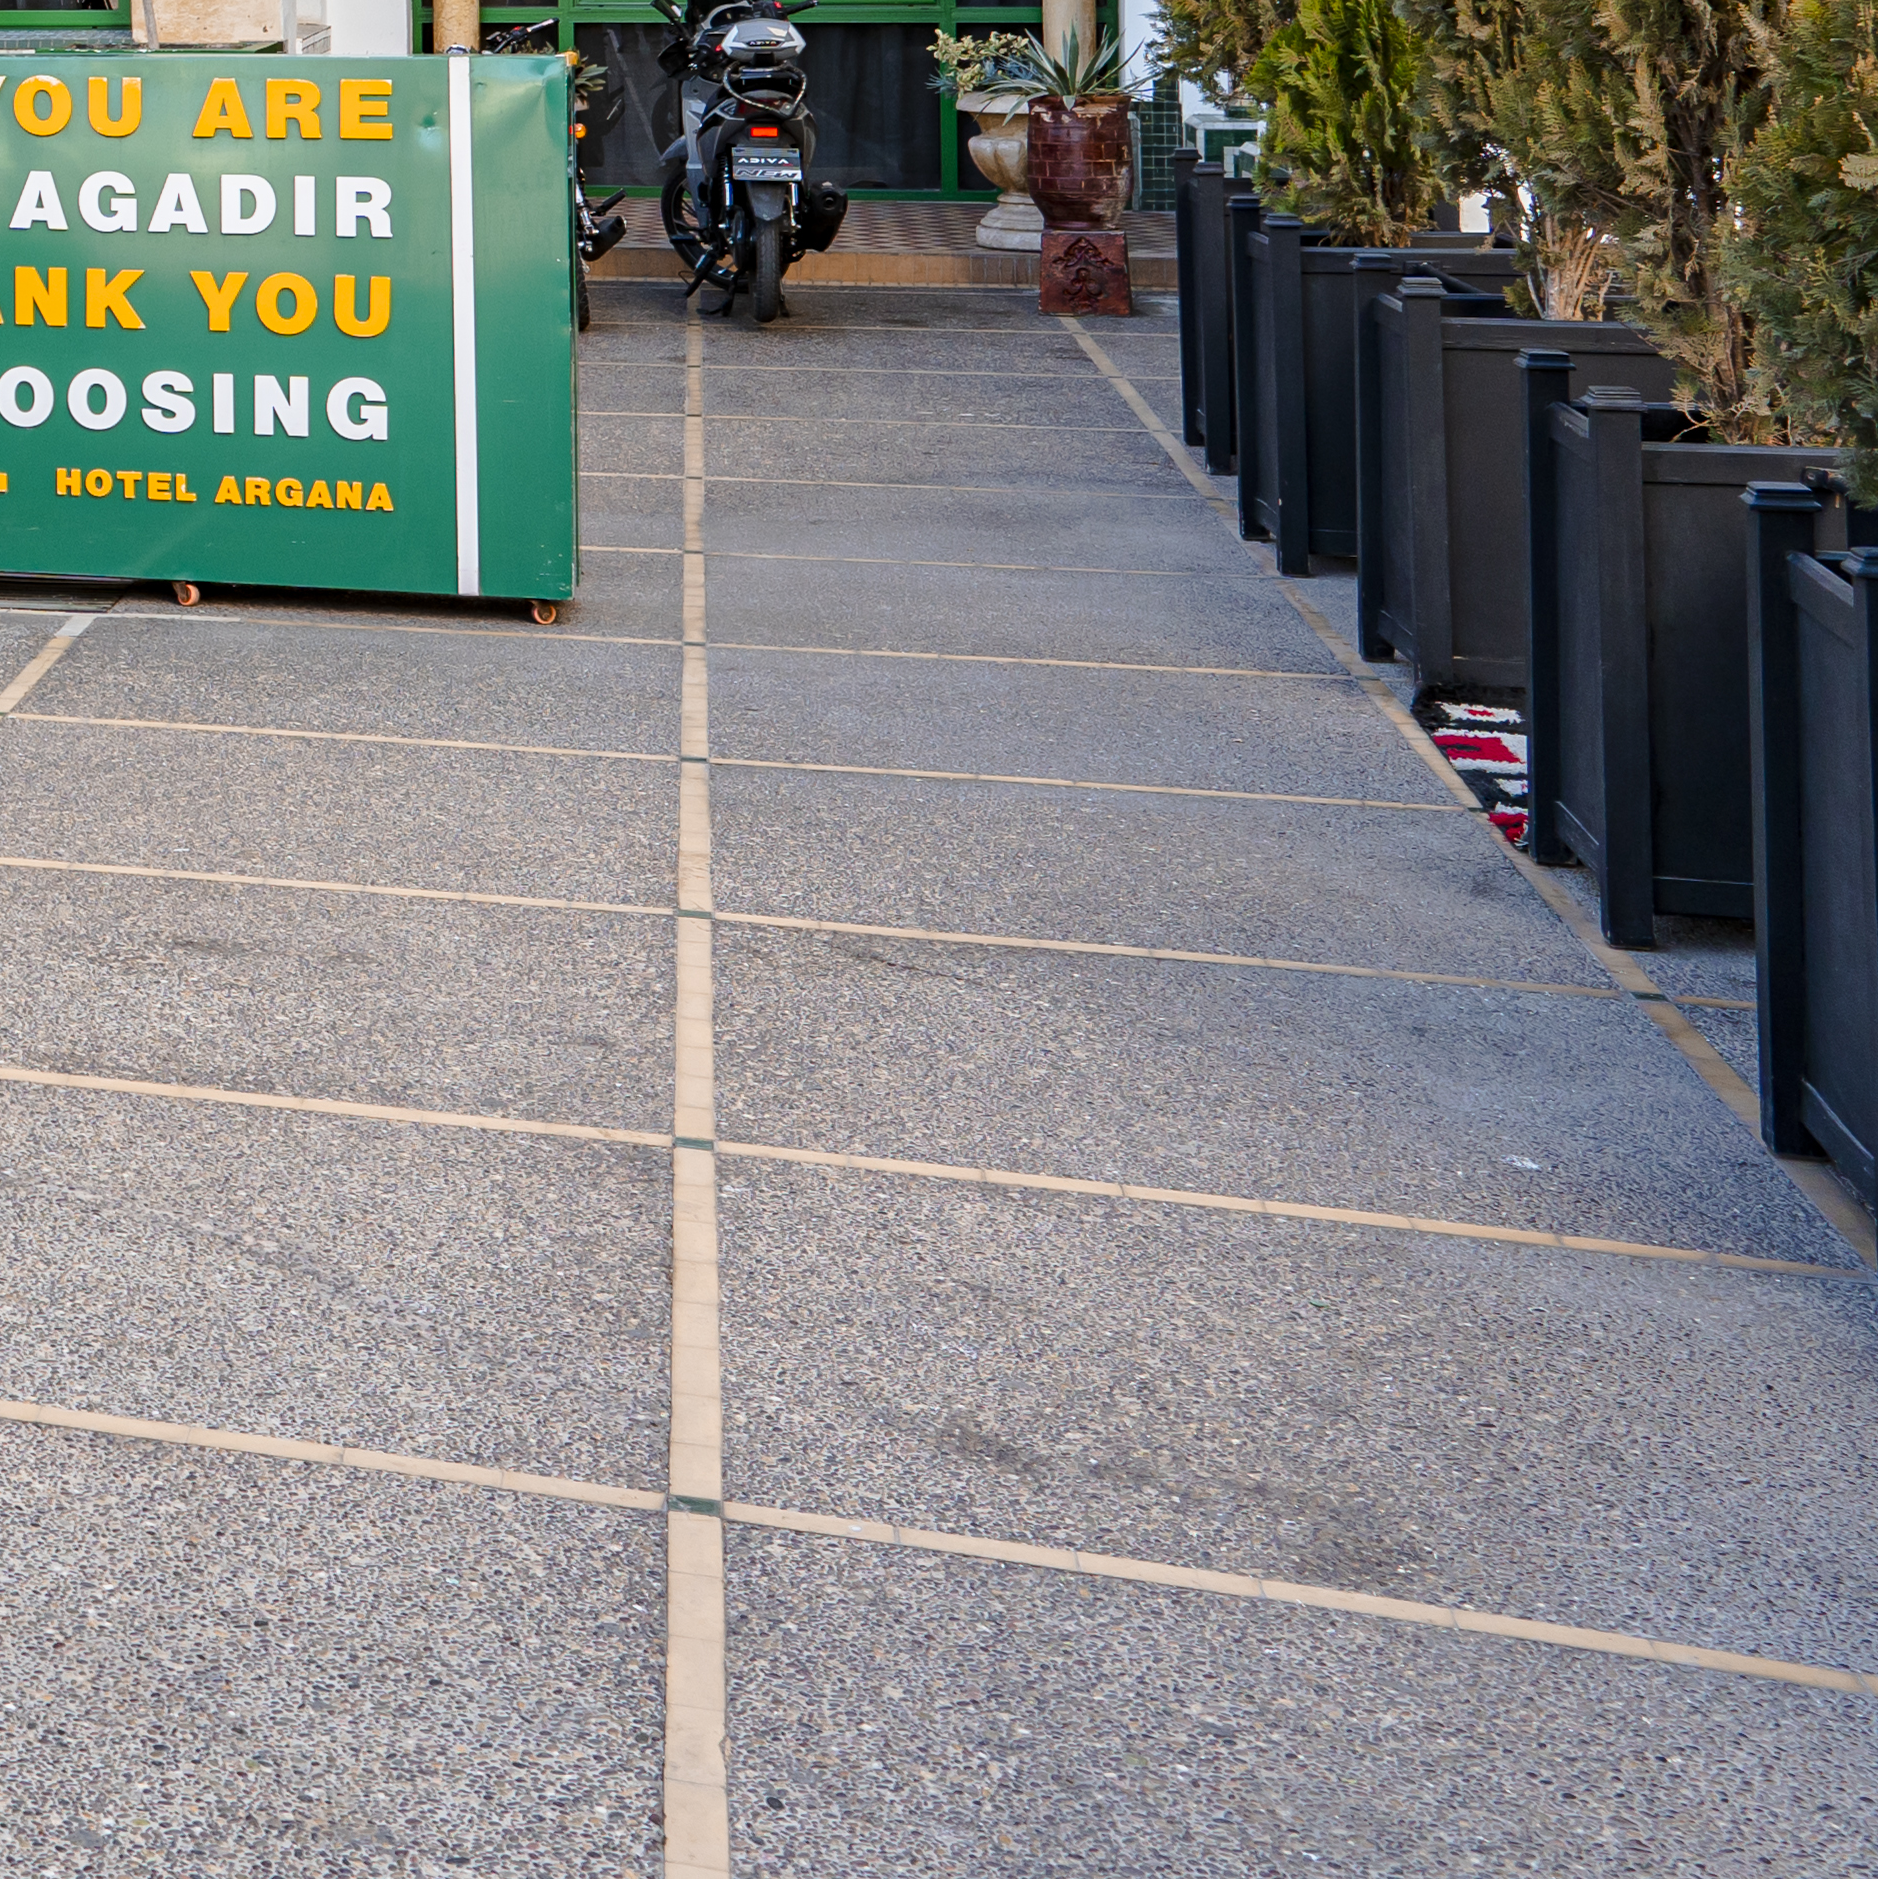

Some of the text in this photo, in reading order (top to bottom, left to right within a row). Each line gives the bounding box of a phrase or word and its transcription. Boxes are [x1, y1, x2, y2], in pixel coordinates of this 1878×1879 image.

[192, 77, 395, 142] ARE
[9, 169, 394, 239] AGADIR
[190, 270, 391, 338] YOU
[54, 468, 394, 513] HOTEL ARGANA
